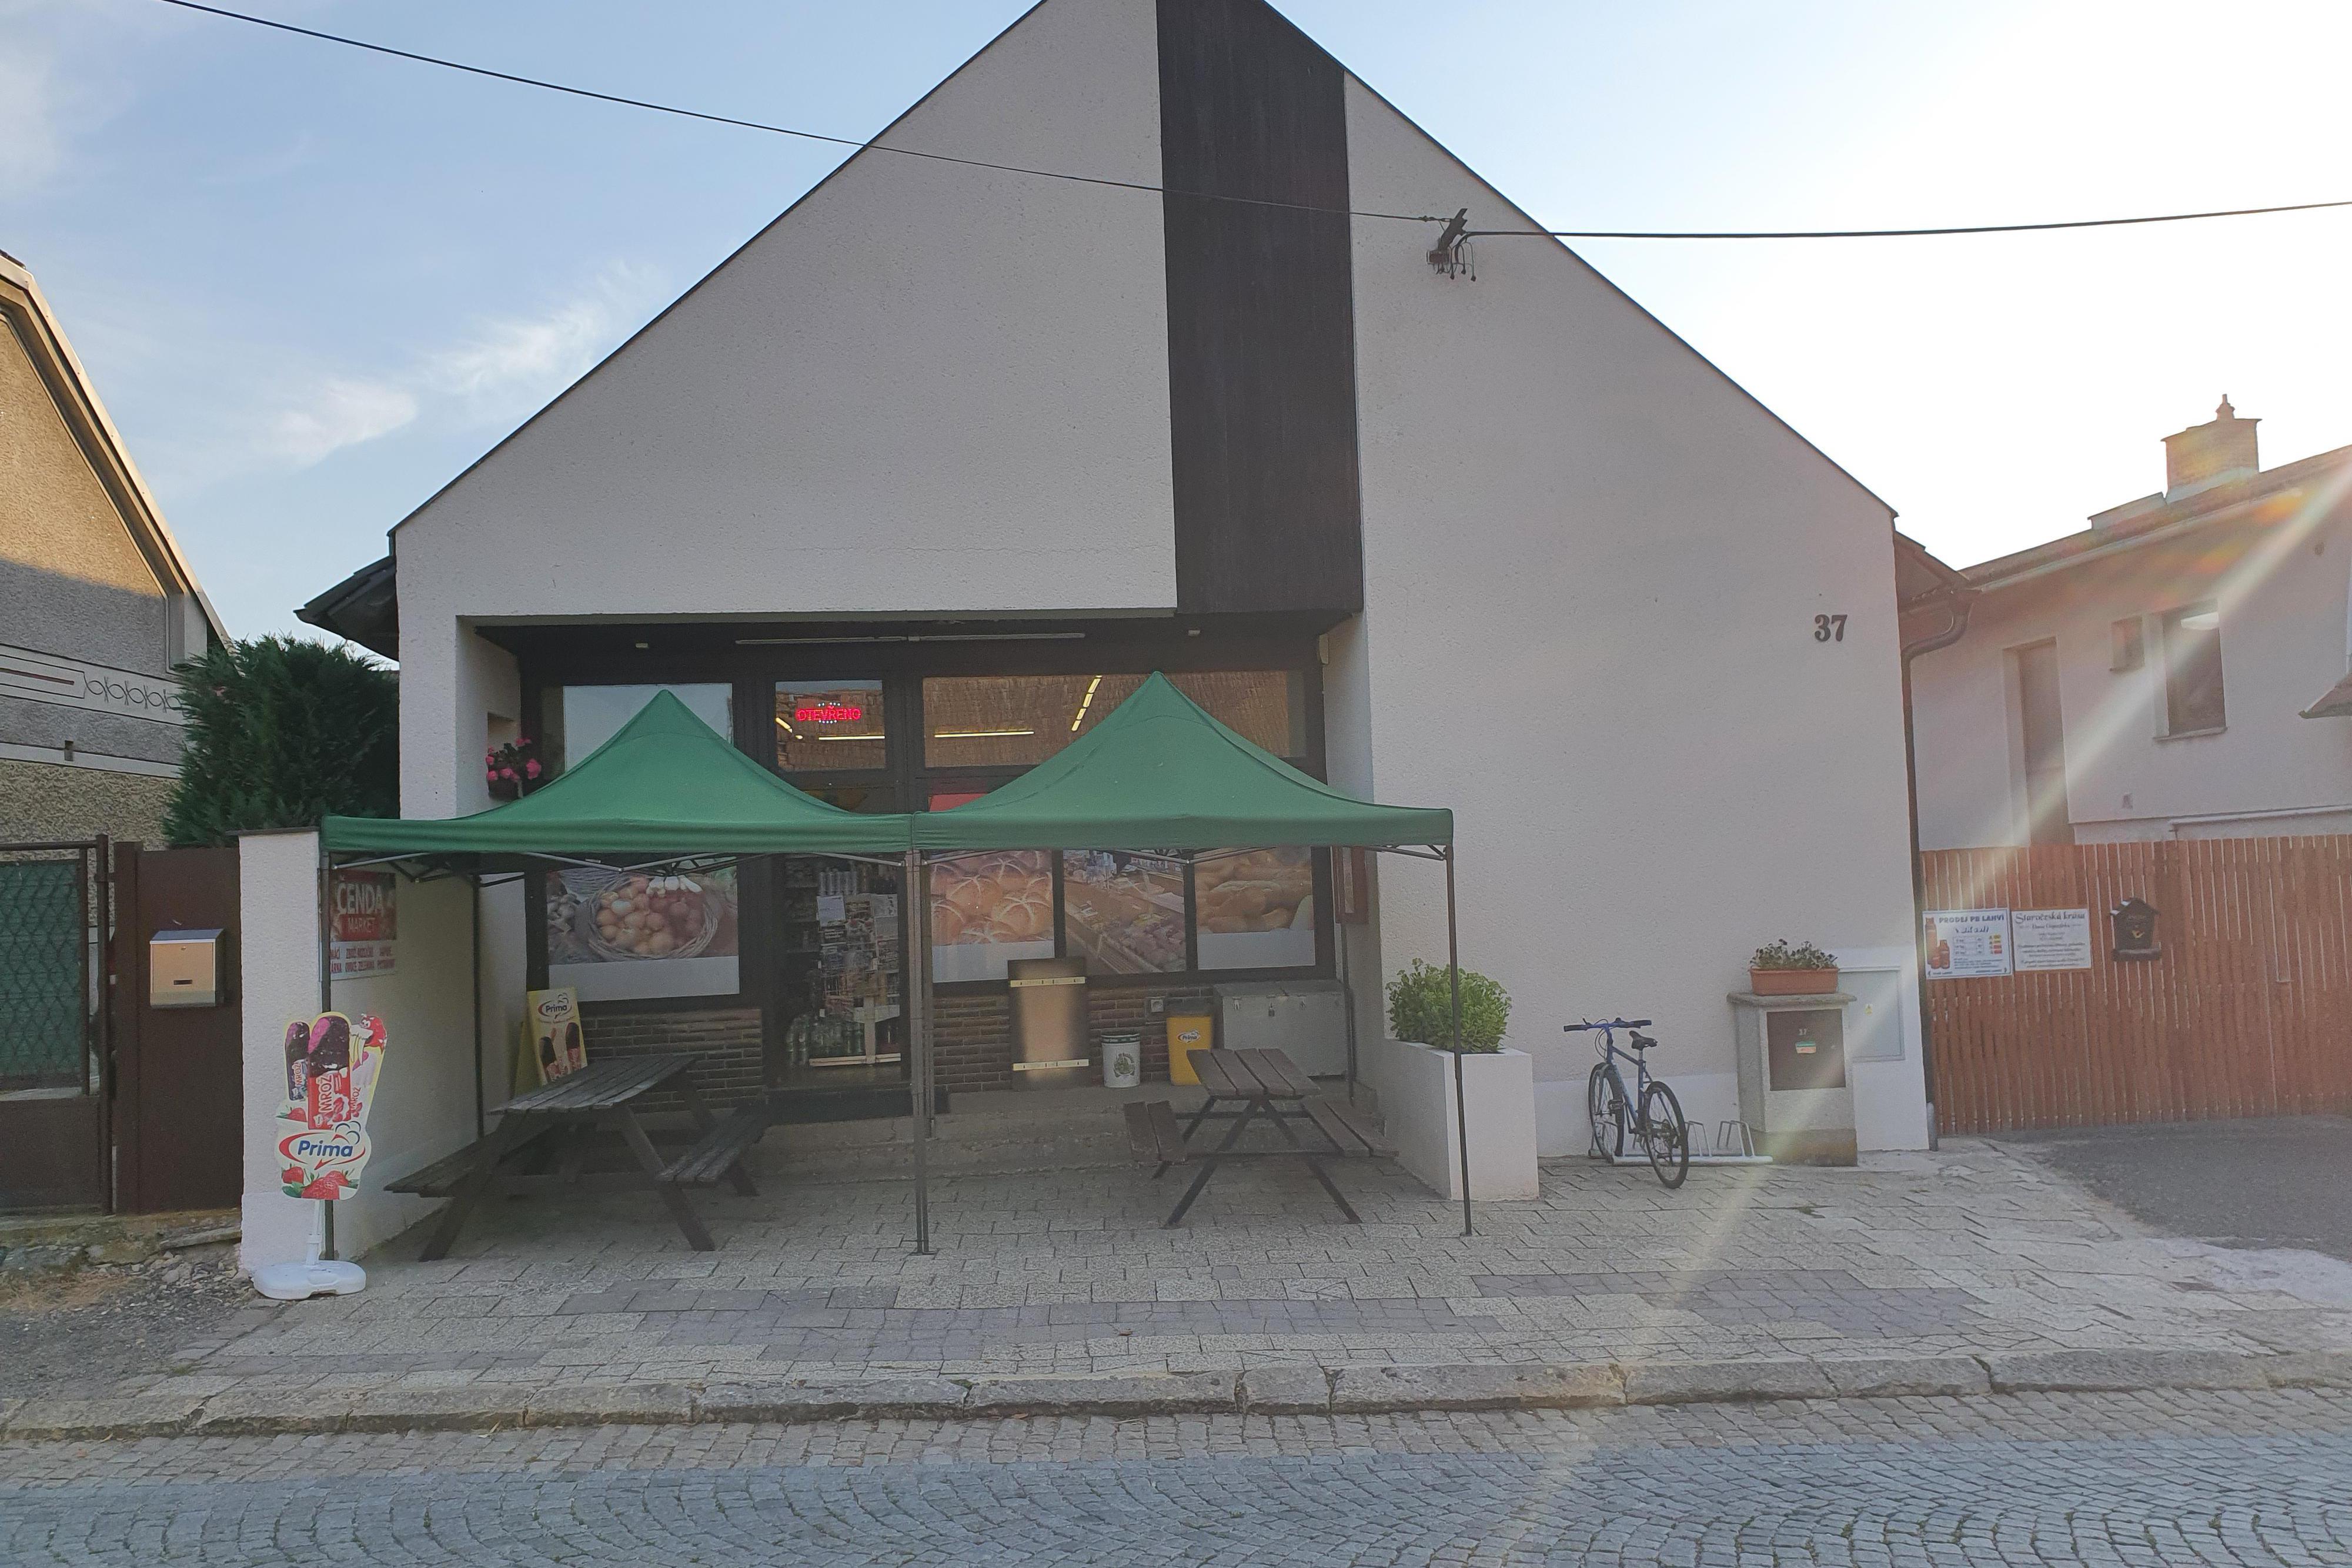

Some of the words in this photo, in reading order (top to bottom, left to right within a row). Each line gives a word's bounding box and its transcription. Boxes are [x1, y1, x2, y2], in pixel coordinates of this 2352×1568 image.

[1815, 614, 1847, 642] 37
[796, 706, 861, 721] OTEVŘENO
[546, 1004, 567, 1012] Prima
[298, 1140, 354, 1157] Prima
